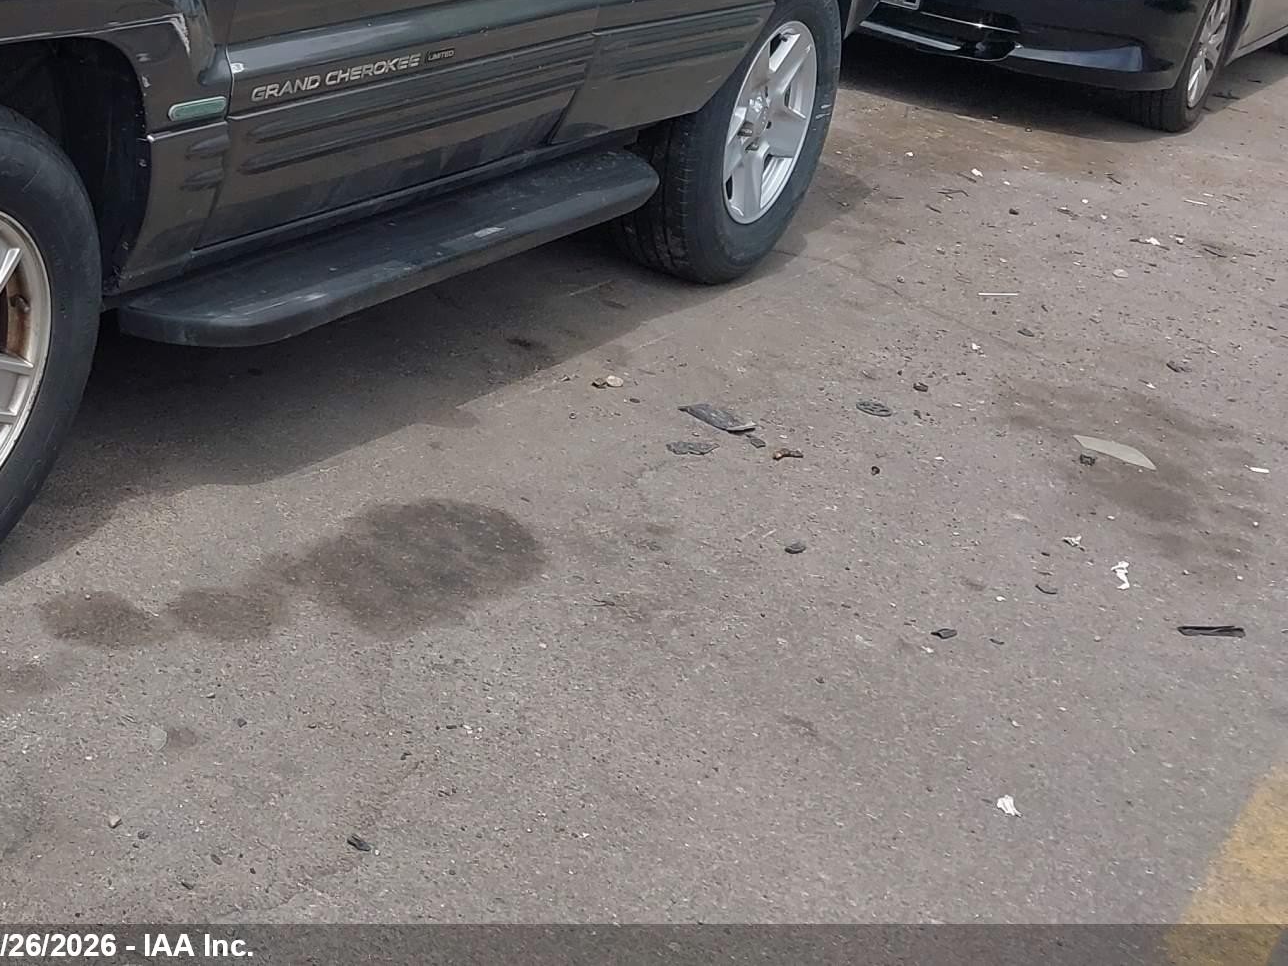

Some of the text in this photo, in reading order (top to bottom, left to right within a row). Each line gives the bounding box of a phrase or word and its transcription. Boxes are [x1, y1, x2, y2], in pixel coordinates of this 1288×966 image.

[251, 49, 455, 102] GRAND CHEROKEE LIMITED
